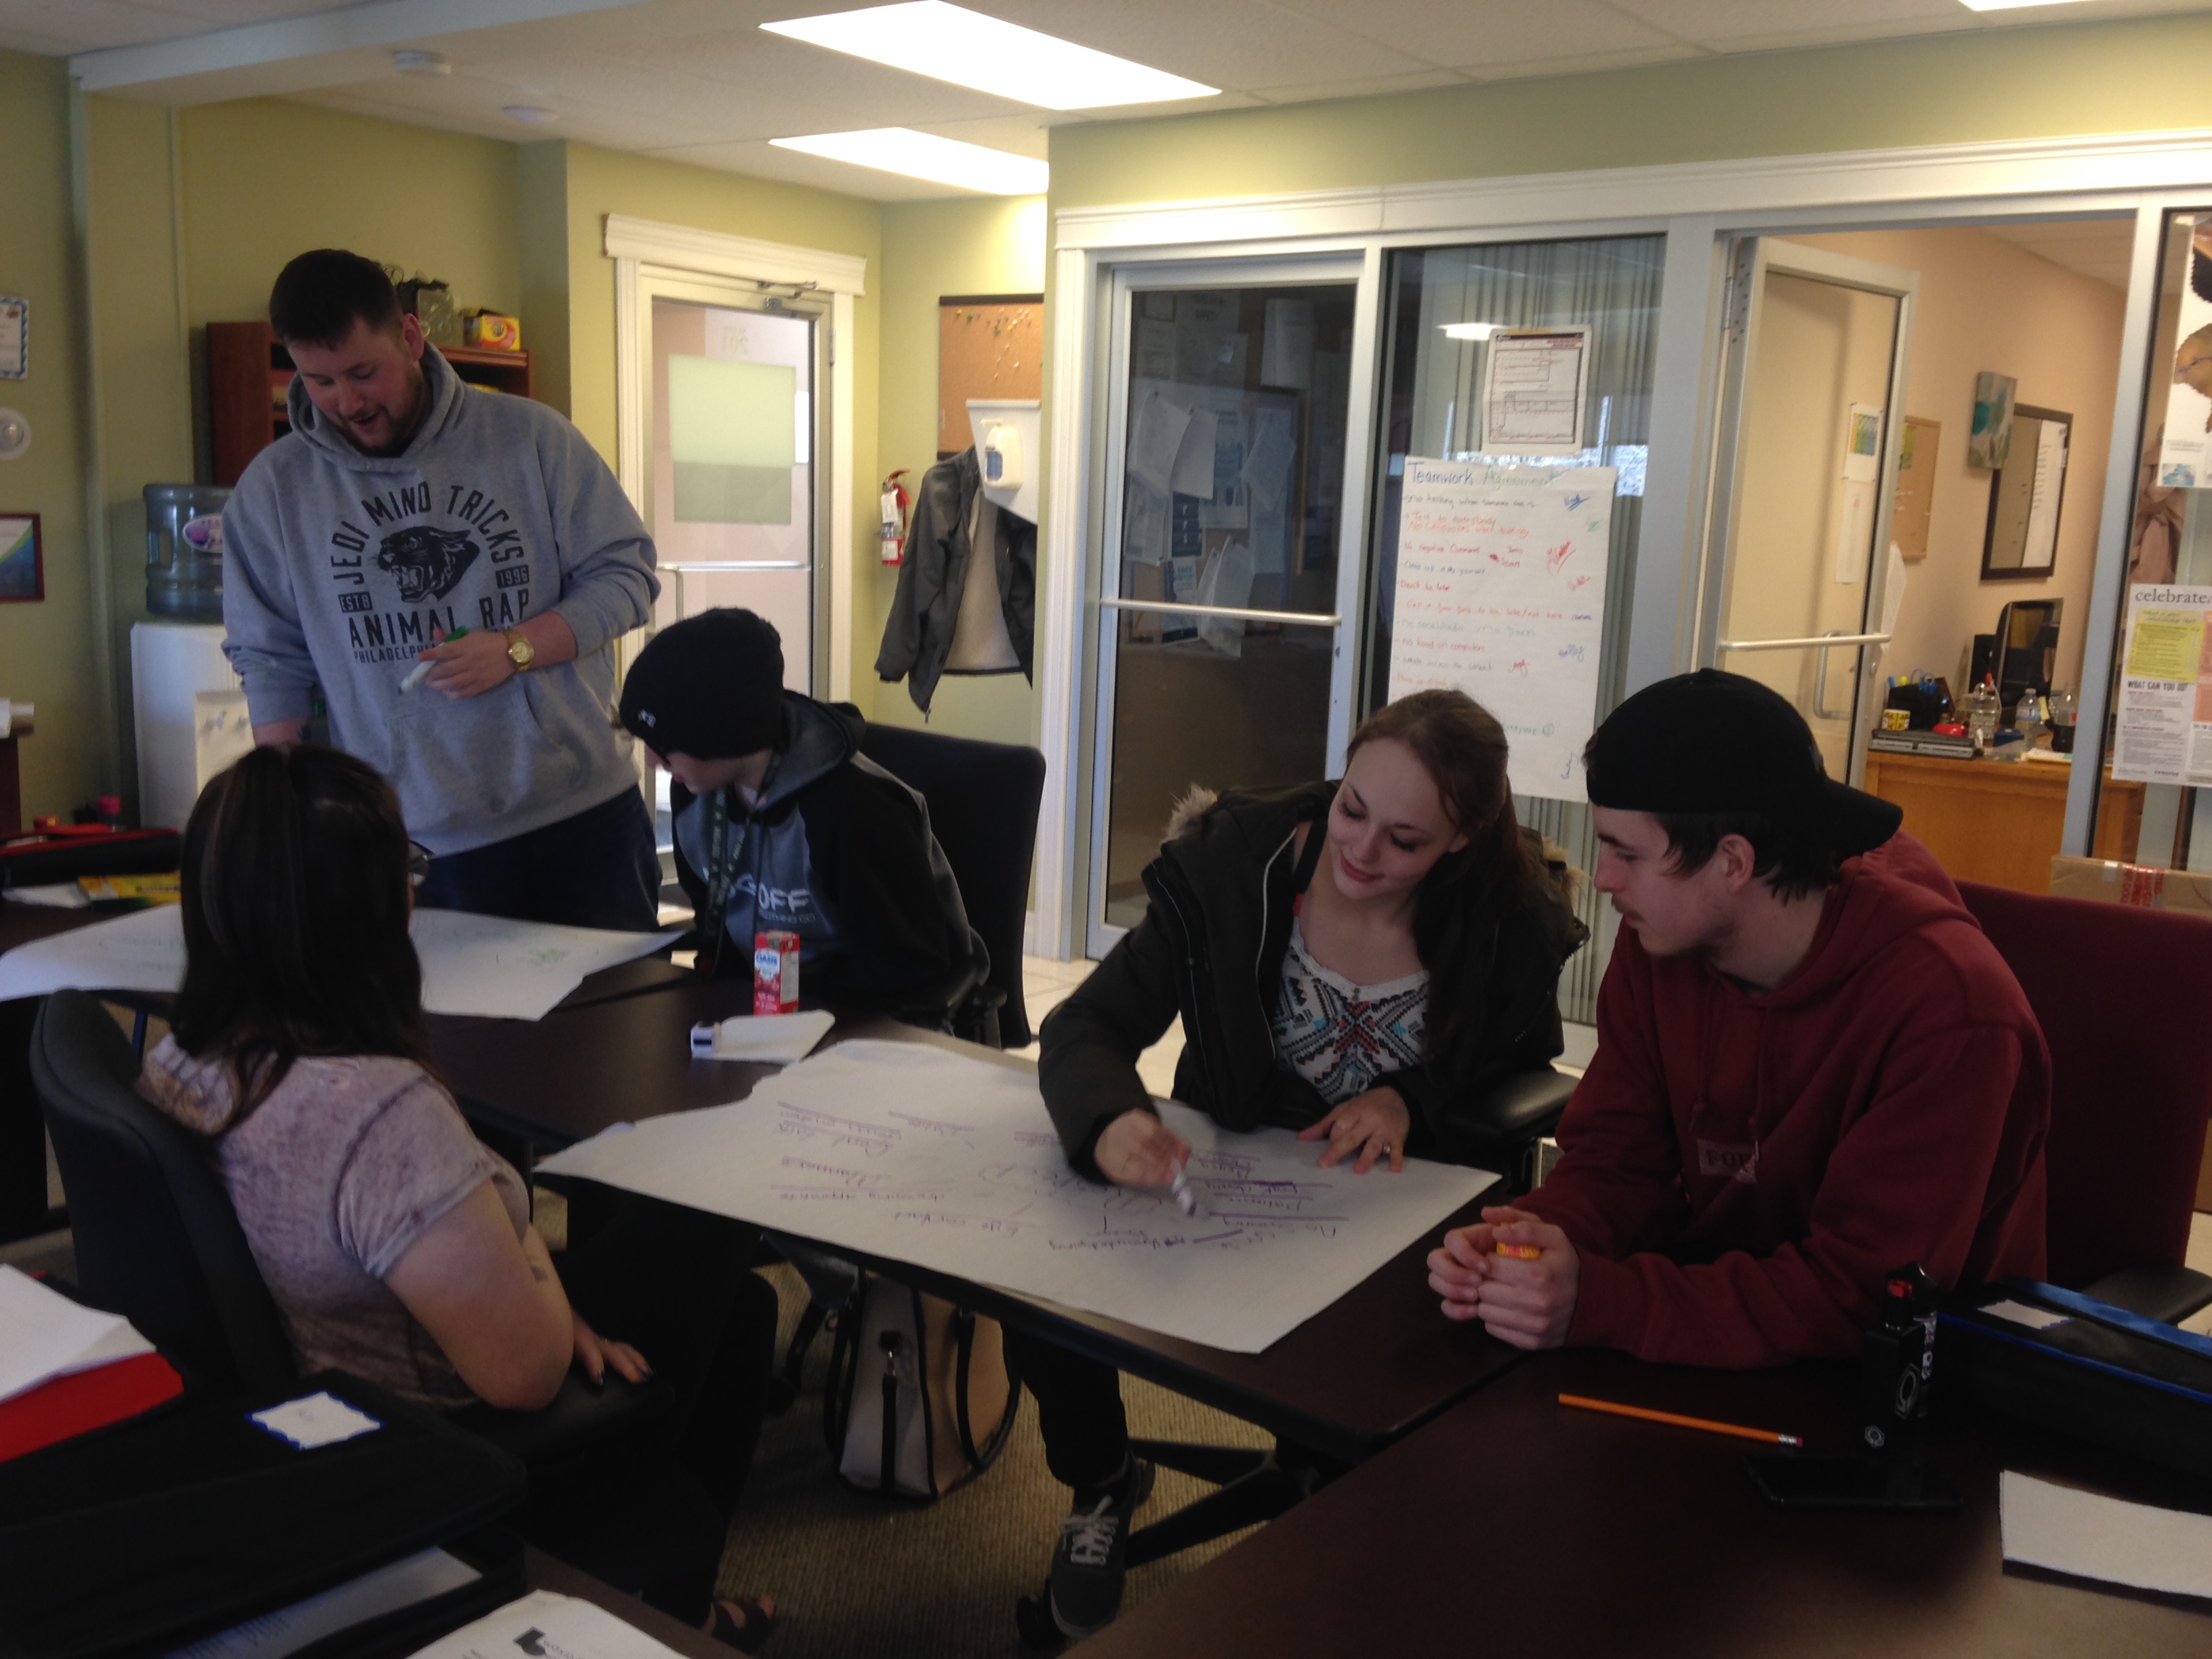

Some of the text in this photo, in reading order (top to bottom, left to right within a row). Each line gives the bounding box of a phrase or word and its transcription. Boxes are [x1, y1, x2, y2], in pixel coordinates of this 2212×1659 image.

[1408, 462, 1473, 486] Teamwork
[331, 481, 525, 586] JEDI MIND TRICKS
[500, 566, 529, 587] 1996
[479, 588, 529, 629] RAP
[2127, 680, 2145, 689] WHAT
[2147, 681, 2160, 690] CAN
[2163, 682, 2175, 691] YOU
